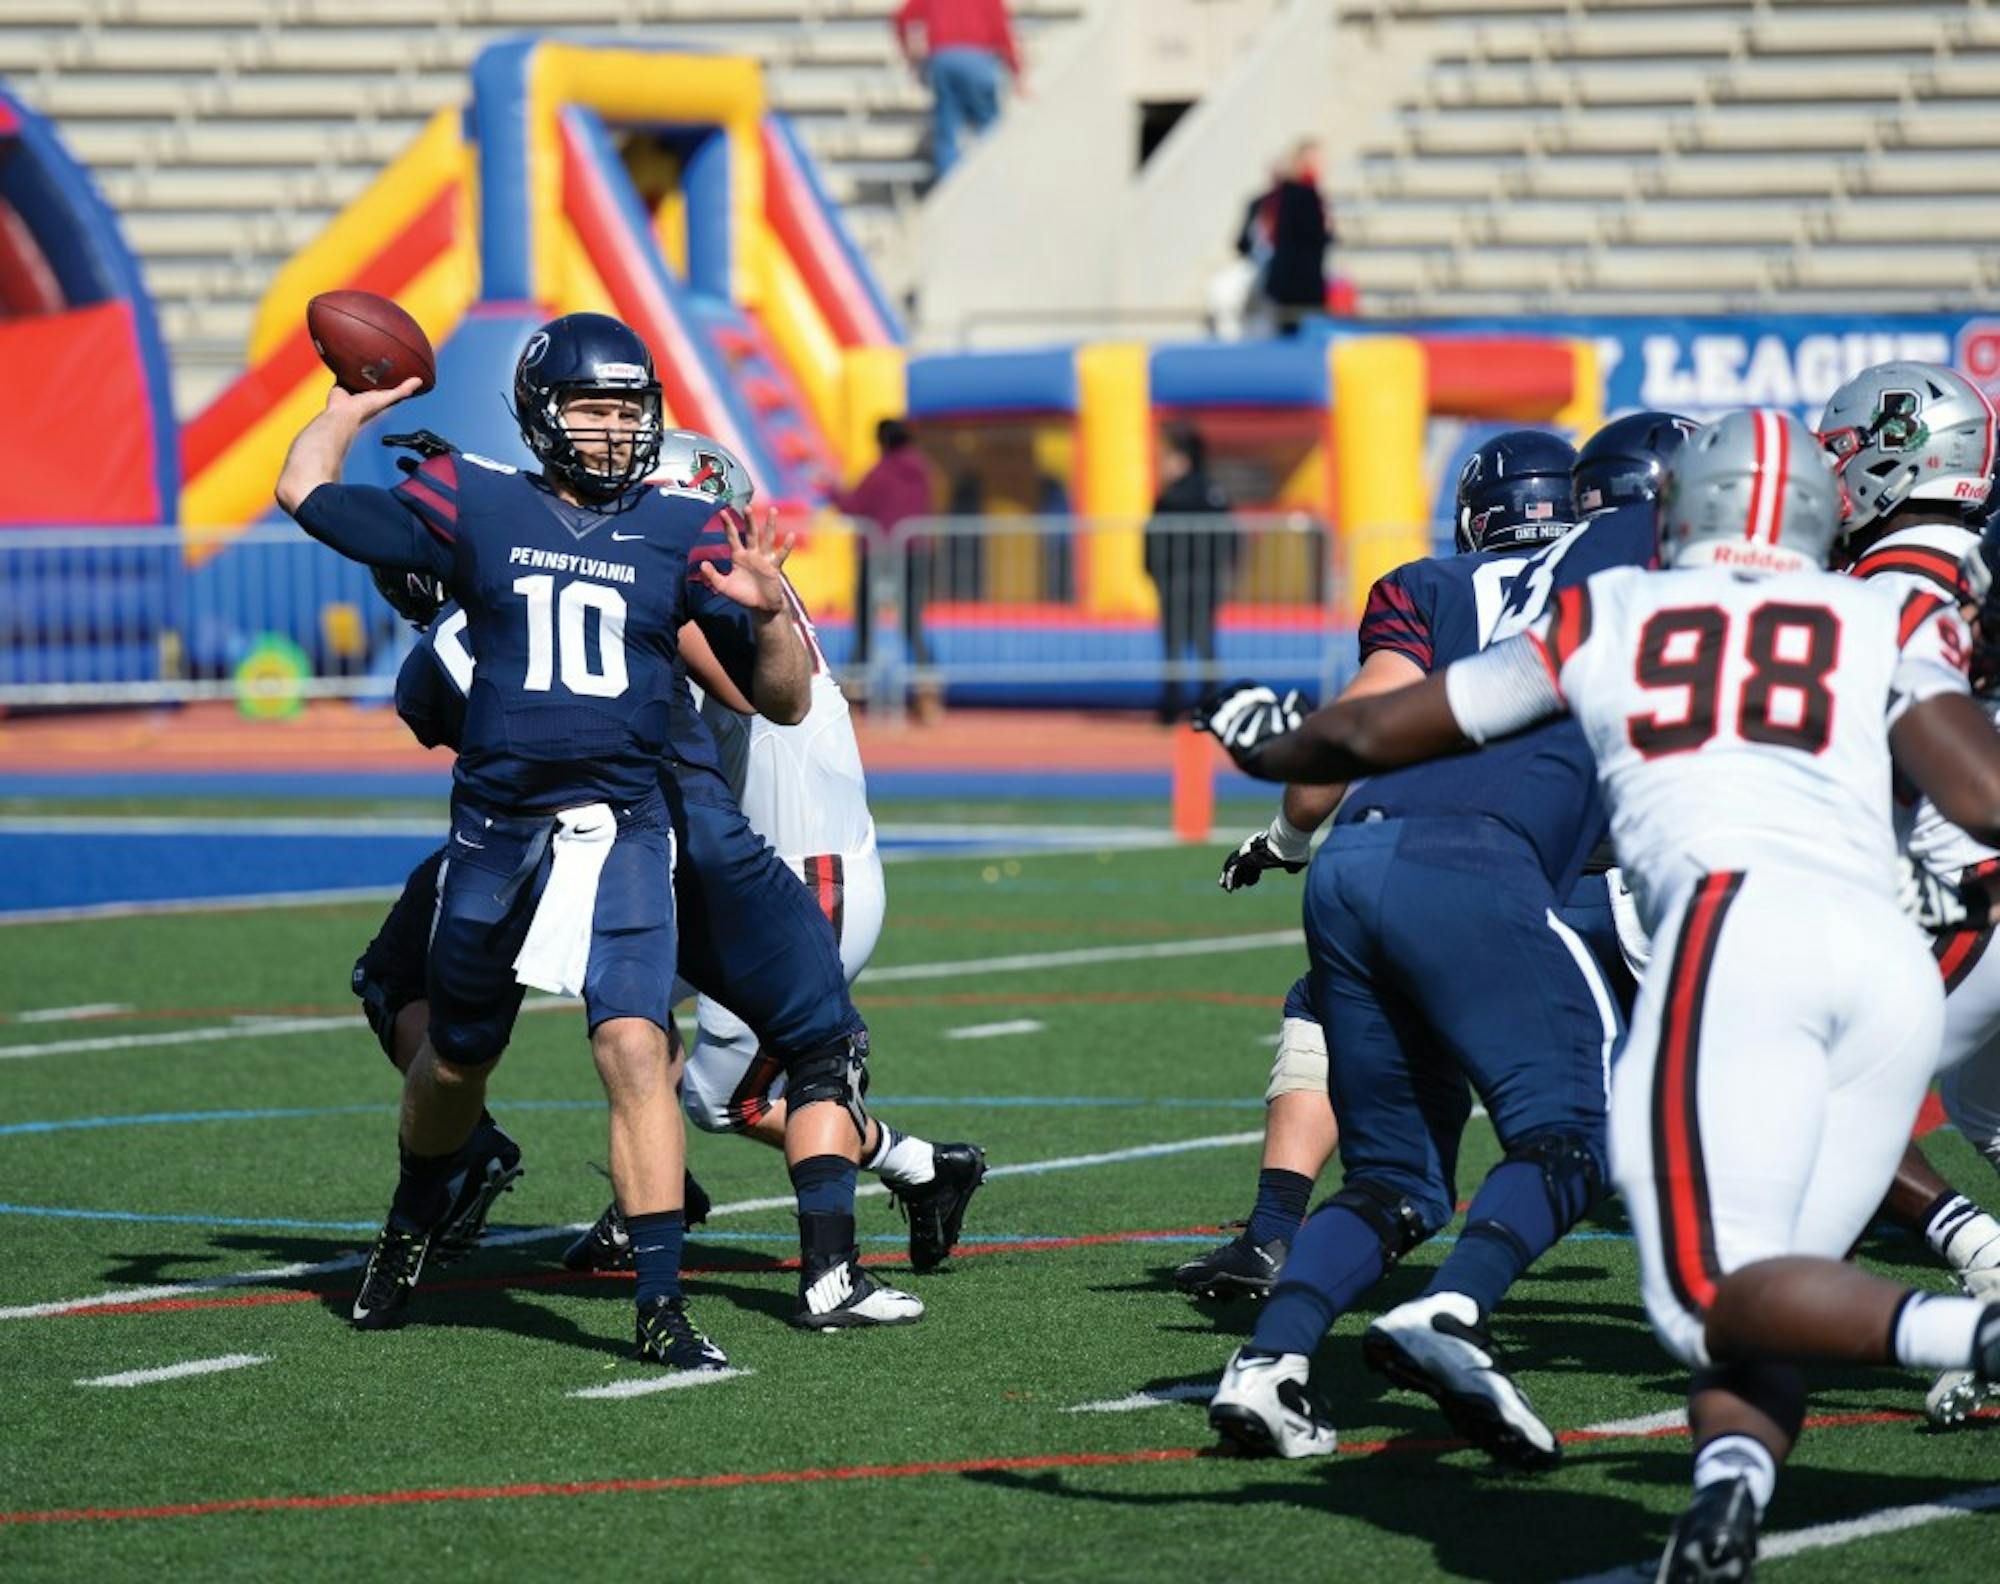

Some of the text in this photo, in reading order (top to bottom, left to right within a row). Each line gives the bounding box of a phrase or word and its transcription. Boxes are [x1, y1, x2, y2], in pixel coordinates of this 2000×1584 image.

[509, 547, 636, 584] PENNSYLVANIA
[513, 574, 630, 699] 10
[1627, 600, 1842, 764] 98
[805, 1261, 854, 1316] NIKE
